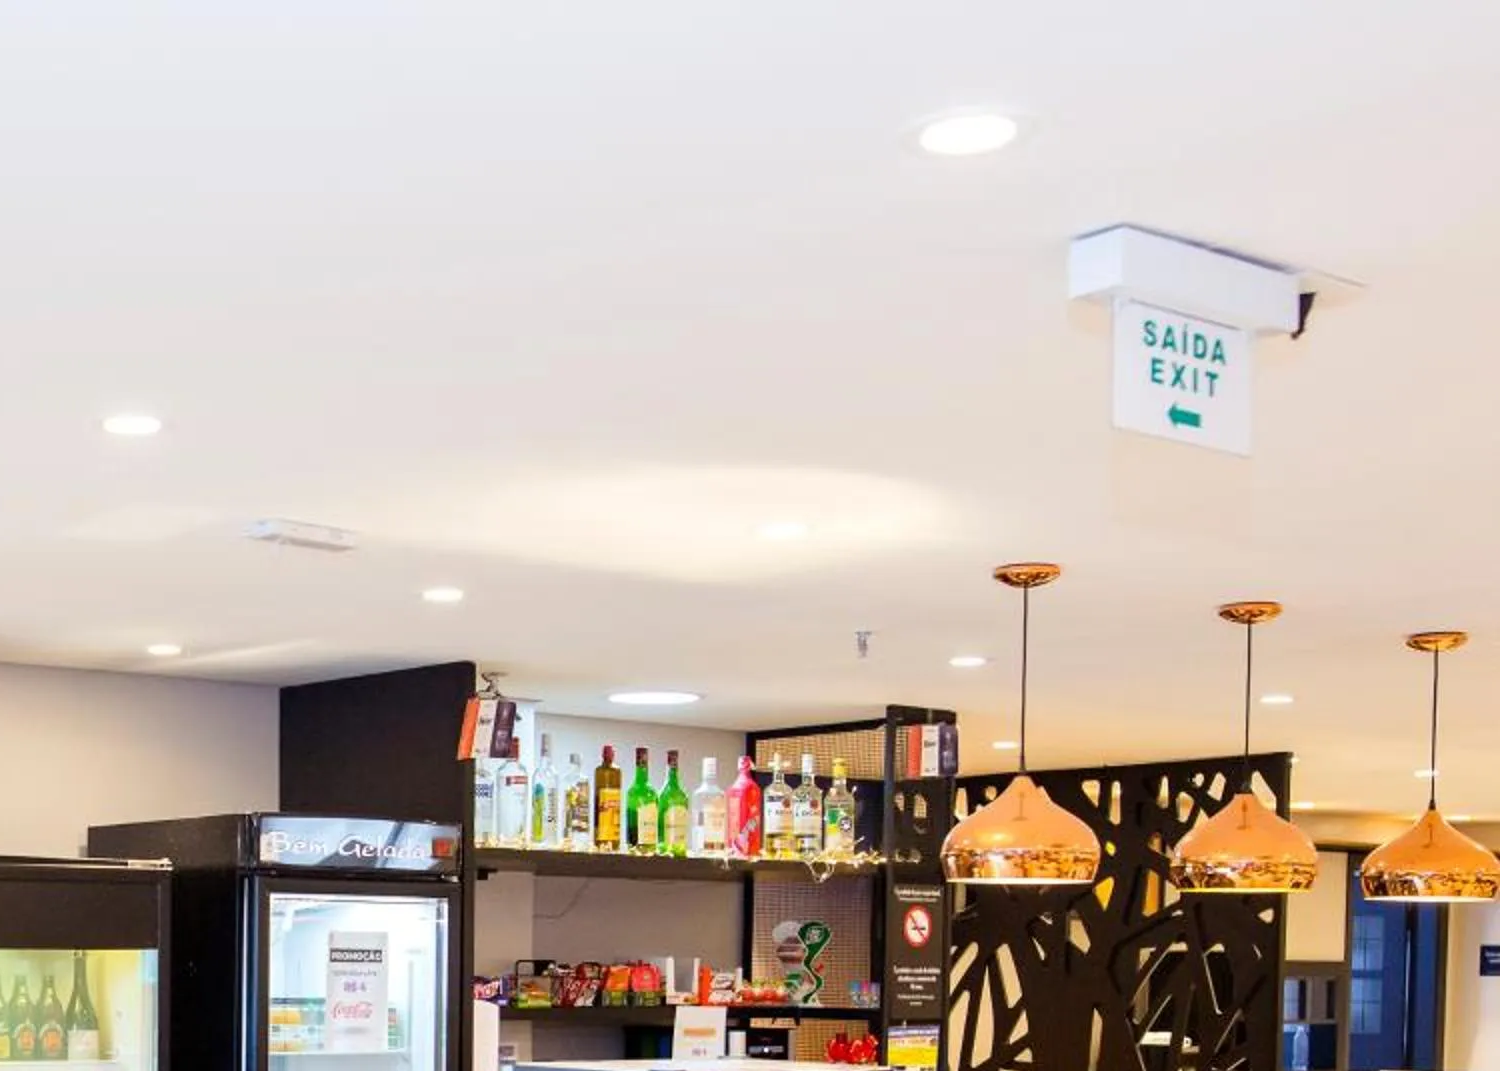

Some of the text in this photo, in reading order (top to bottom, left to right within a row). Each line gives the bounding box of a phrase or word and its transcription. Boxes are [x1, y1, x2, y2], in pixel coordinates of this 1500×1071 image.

[1142, 319, 1227, 366] SAÍDA
[1150, 356, 1219, 398] EXIT
[269, 829, 327, 857] Bem
